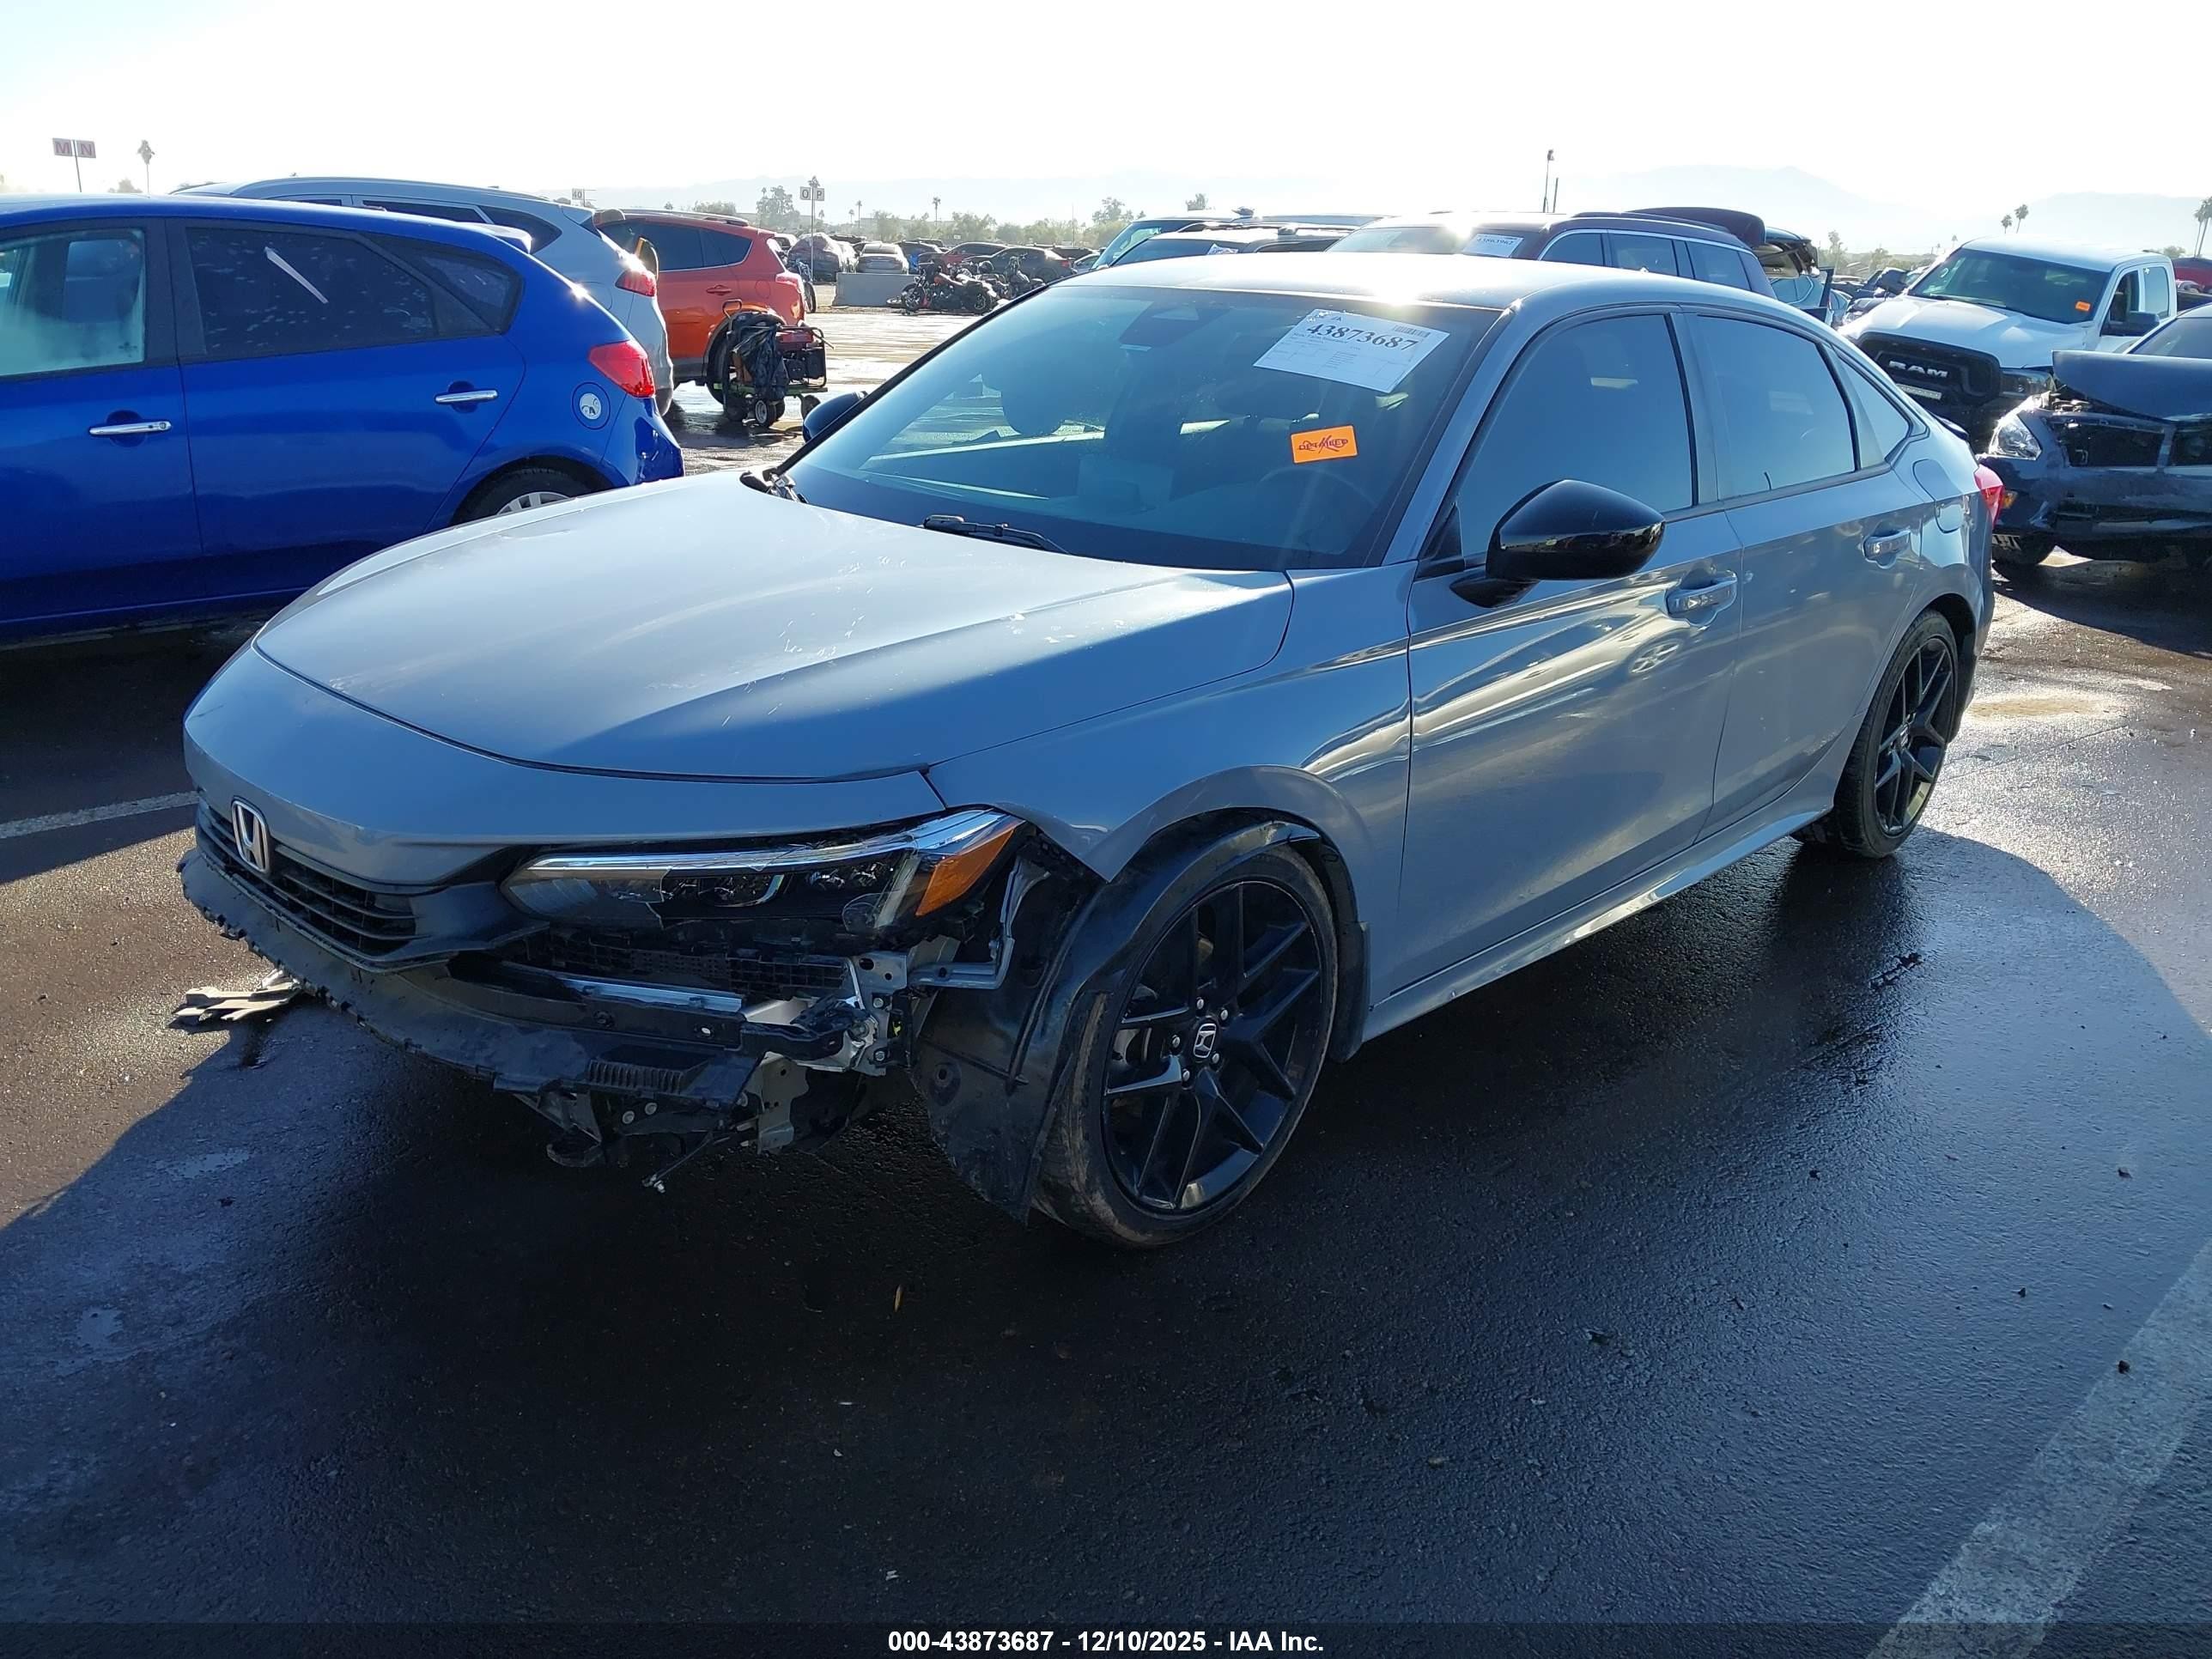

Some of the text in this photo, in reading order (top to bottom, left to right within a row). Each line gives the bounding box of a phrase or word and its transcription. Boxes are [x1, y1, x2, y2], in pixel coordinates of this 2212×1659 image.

[55, 142, 70, 154] M
[81, 143, 93, 155] N
[817, 190, 823, 199] P
[1307, 323, 1419, 350] 43873687
[1889, 361, 1948, 378] RAM
